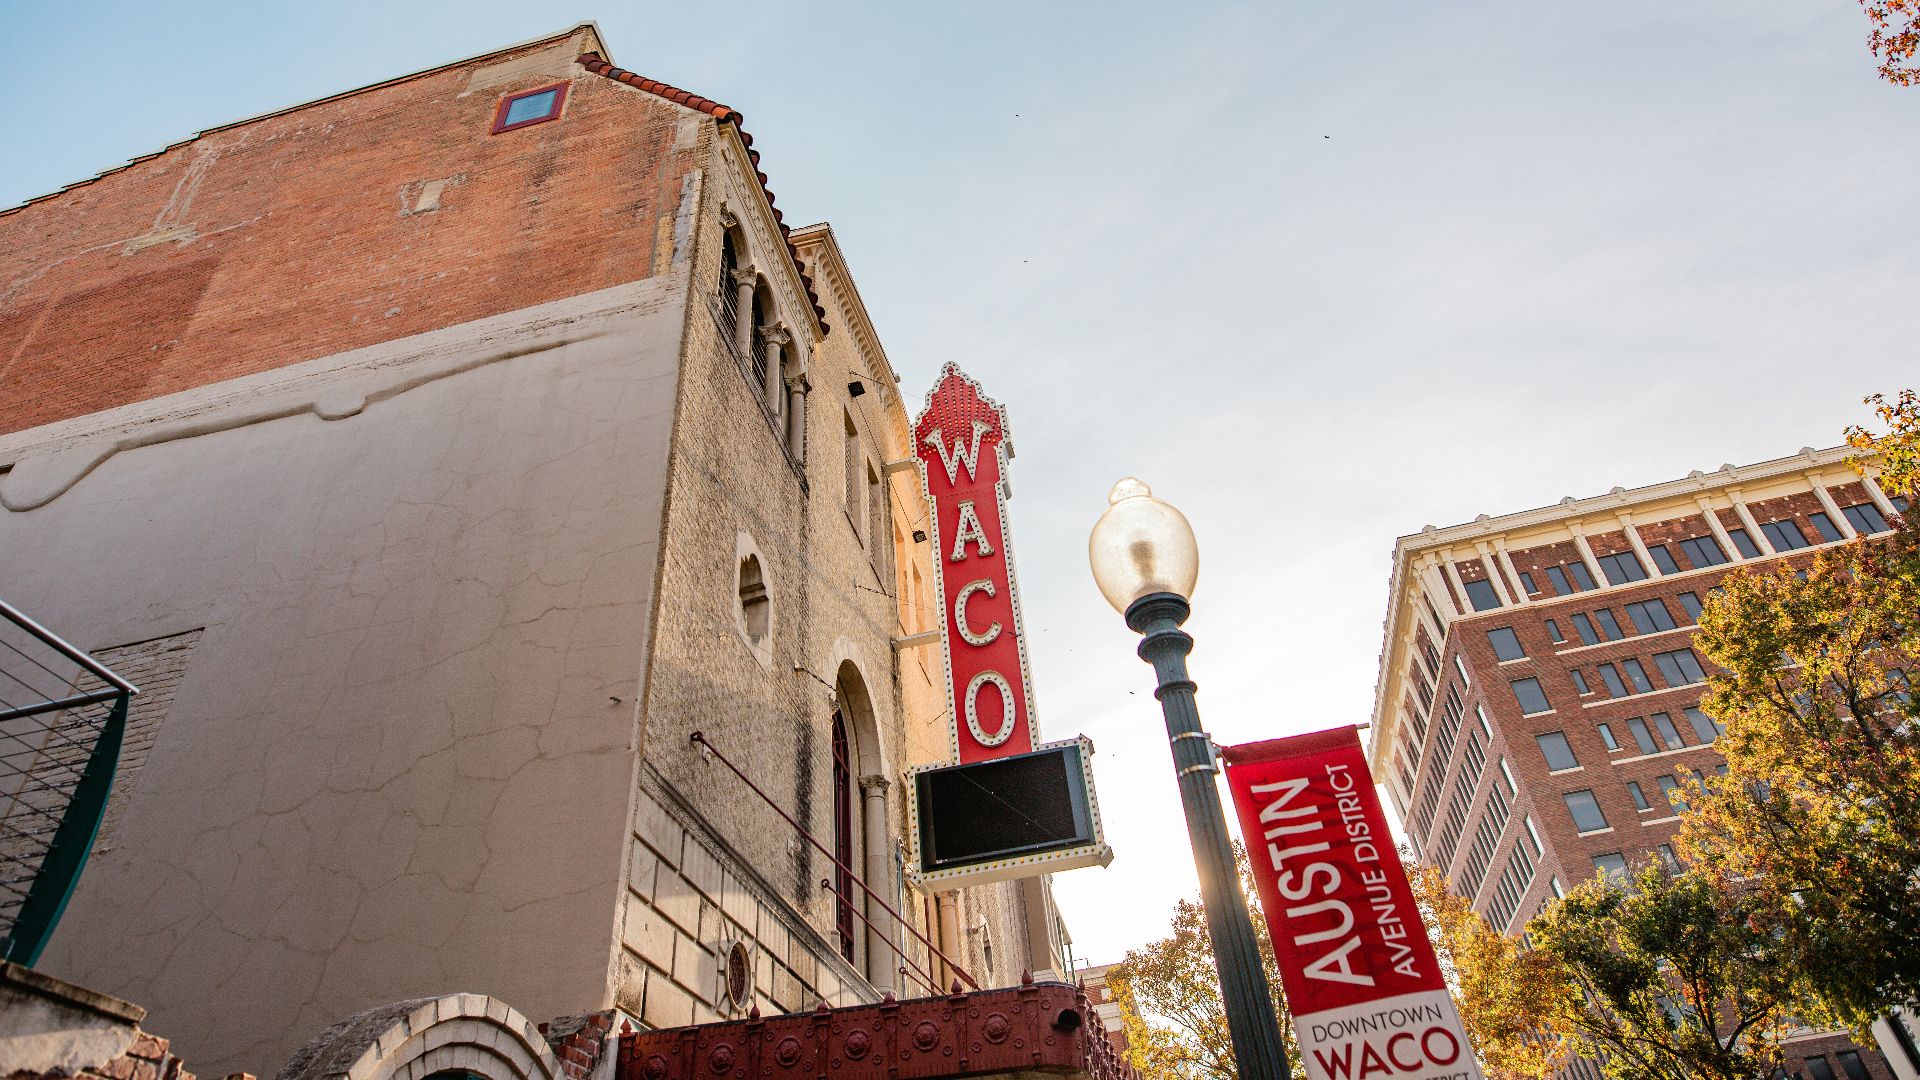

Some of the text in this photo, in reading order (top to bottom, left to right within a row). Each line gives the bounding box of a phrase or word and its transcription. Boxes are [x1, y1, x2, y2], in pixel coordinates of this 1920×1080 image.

[924, 419, 1016, 748] WACO
[1251, 777, 1375, 987] AUSTIN
[1325, 764, 1421, 978] AVENUE DISTRICT
[1312, 1003, 1443, 1043] DOWNTOWN
[1312, 1026, 1460, 1080] WACO
